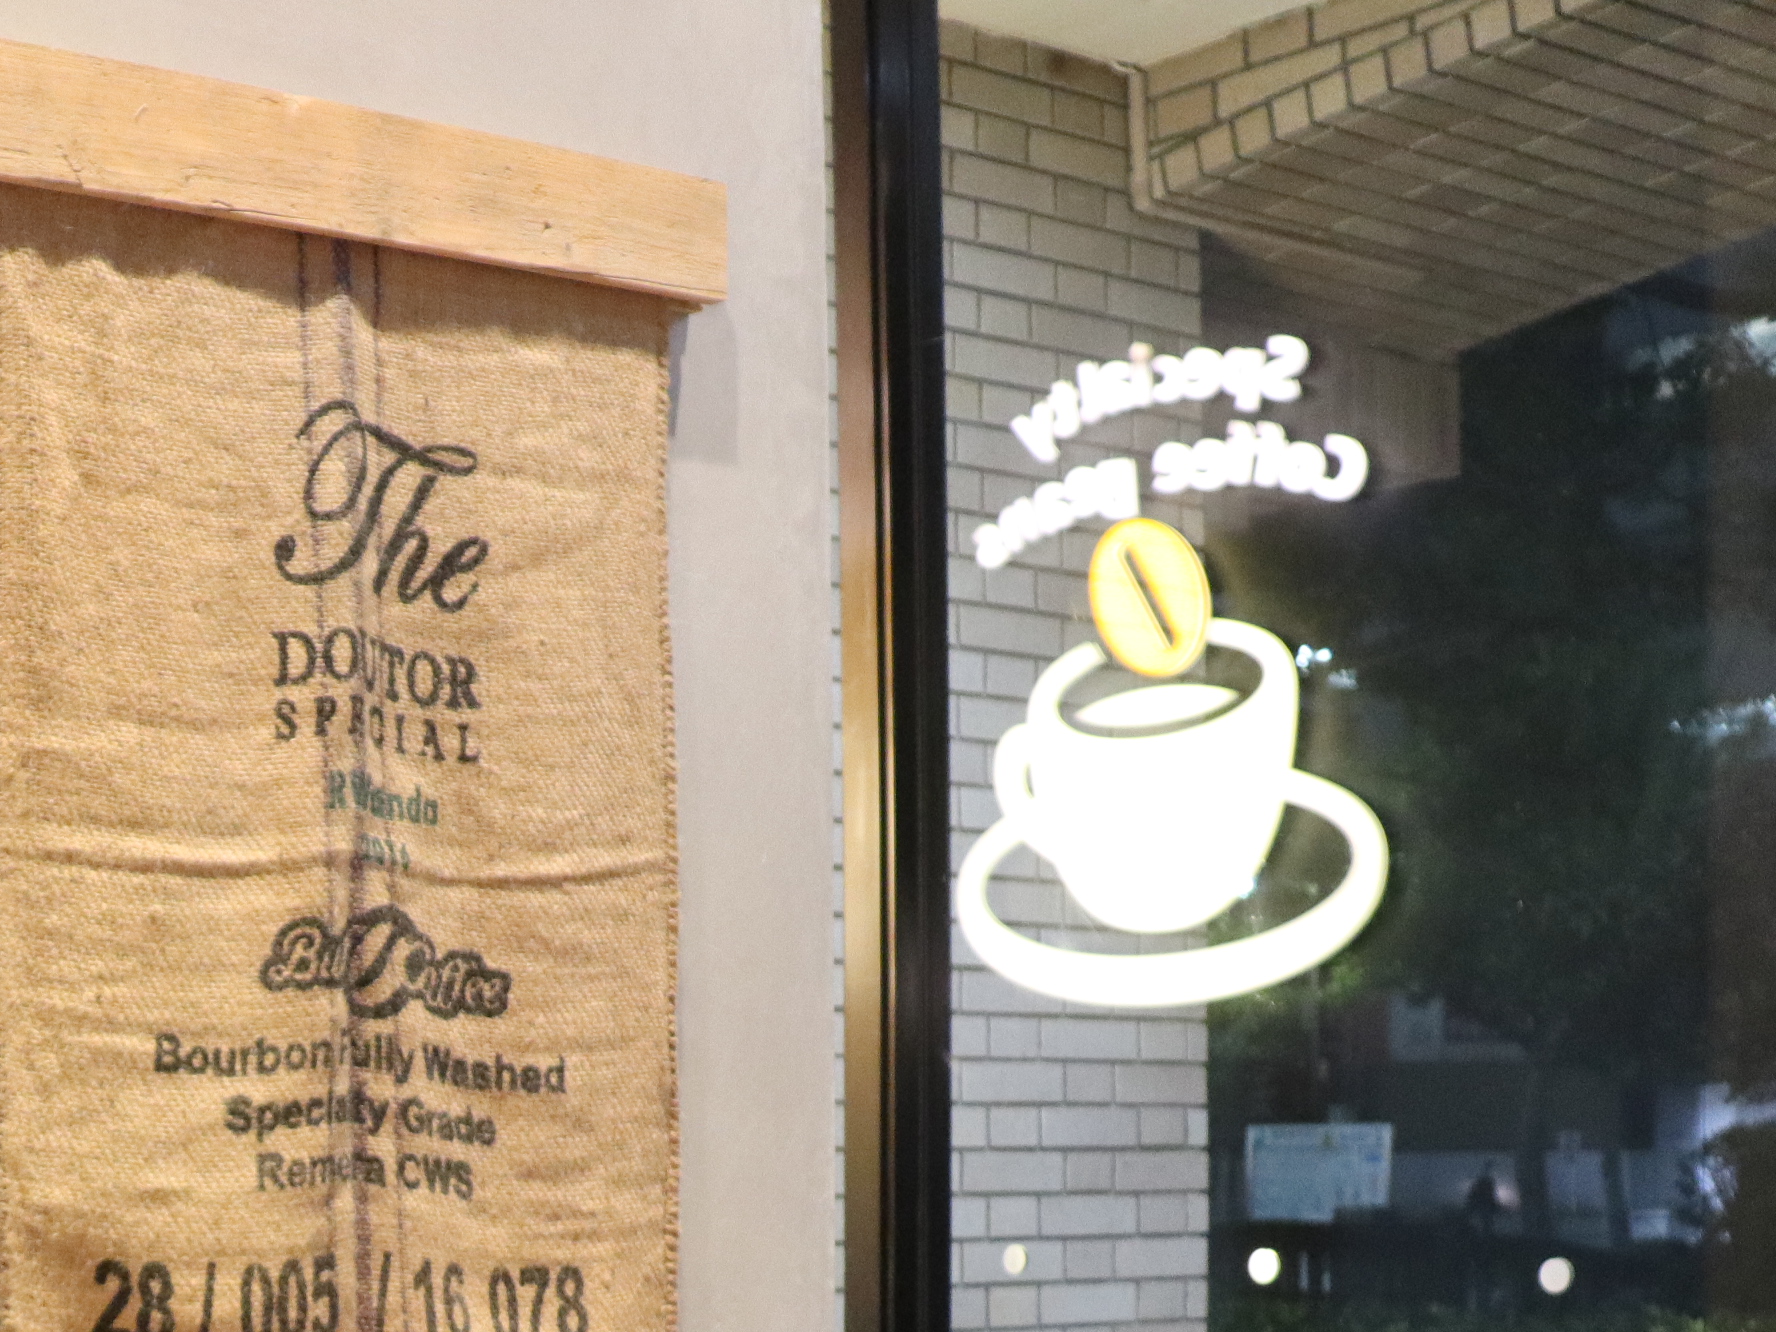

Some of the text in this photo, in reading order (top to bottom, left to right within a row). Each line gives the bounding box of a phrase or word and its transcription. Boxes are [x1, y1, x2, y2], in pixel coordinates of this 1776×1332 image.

[274, 400, 489, 613] The
[153, 1032, 332, 1078] Bourbon
[422, 1043, 567, 1094] Washed
[398, 1096, 497, 1147] Grade
[396, 1152, 474, 1200] CWS
